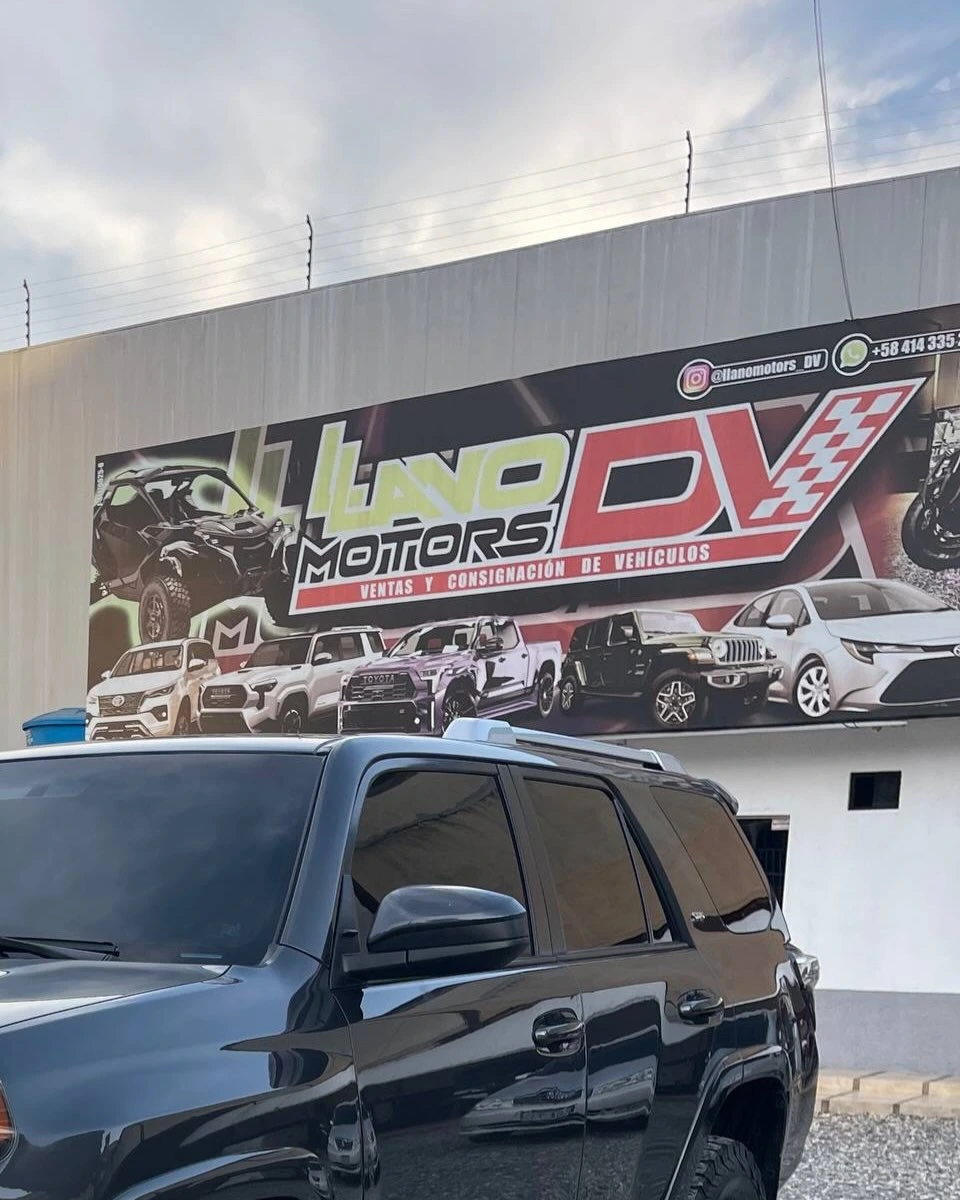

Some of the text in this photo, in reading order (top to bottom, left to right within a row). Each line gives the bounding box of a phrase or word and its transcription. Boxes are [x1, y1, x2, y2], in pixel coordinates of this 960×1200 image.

[711, 353, 822, 384] @llanomotors_DV
[872, 341, 899, 357] +58
[901, 337, 925, 354] 414
[307, 421, 570, 537] LLANO
[559, 378, 927, 550] DV
[298, 509, 556, 584] MOTORS
[360, 543, 711, 600] VENTAS Y CONSIGNACIÓN DE VEHÍCULOS
[362, 674, 395, 685] TOYOTA
